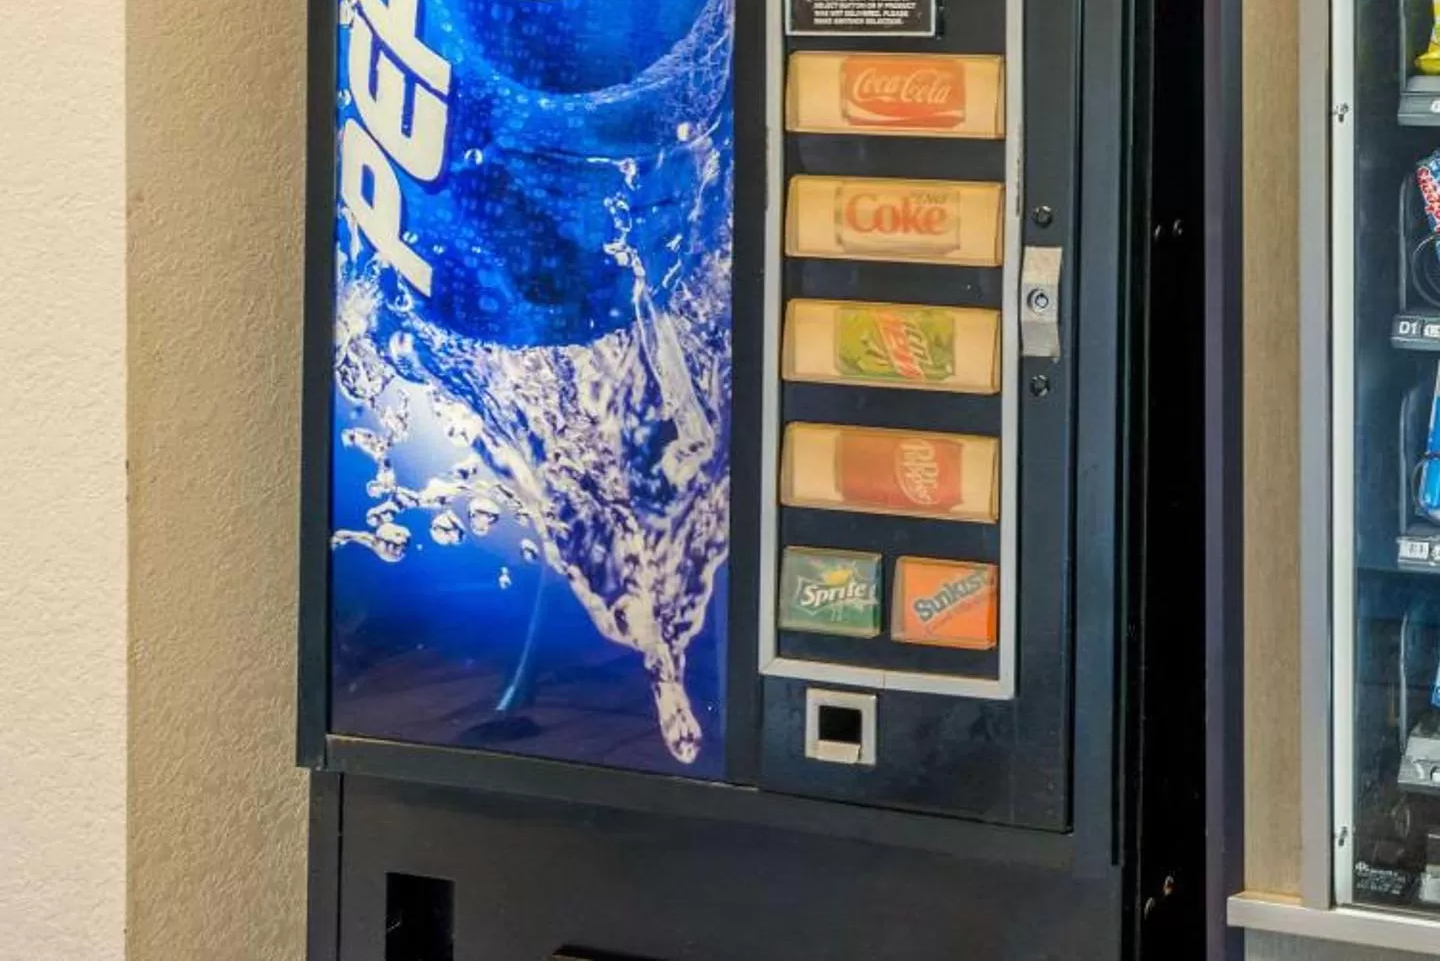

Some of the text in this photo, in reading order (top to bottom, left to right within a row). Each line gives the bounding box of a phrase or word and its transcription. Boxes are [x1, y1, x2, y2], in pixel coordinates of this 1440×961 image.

[846, 193, 948, 235] Coke
[1400, 322, 1418, 334] D1
[801, 582, 867, 609] Sprite
